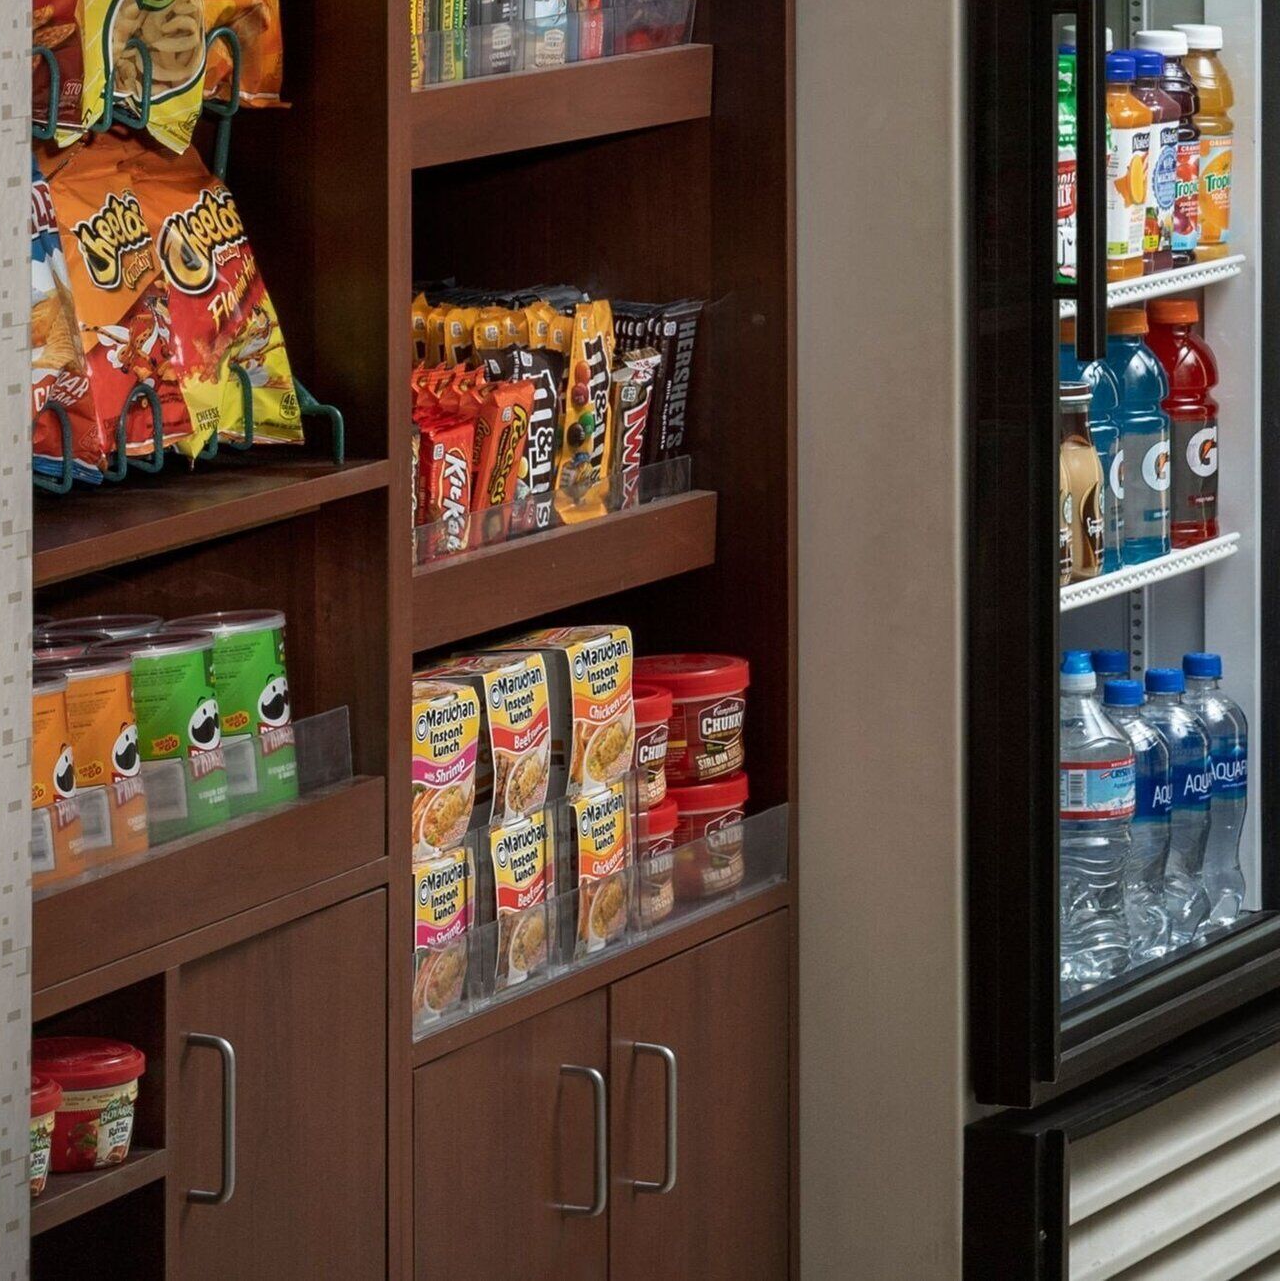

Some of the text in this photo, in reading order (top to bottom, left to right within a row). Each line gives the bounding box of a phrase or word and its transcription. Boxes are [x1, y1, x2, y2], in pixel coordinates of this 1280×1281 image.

[667, 320, 697, 449] HERSHEY'S
[196, 407, 220, 423] CHEESE
[491, 403, 528, 507] Reese's
[621, 385, 652, 510] TWIX
[444, 452, 467, 500] Kit
[582, 639, 629, 668] Maruchan
[499, 667, 543, 695] Maruchan
[587, 663, 619, 683] Instant
[592, 677, 617, 695] Lunch
[504, 690, 535, 712] Instant
[590, 700, 620, 719] Chicken
[426, 701, 475, 728] Maruchan
[509, 707, 533, 725] Lunch
[430, 724, 463, 745] Instant
[514, 730, 531, 749] Beef
[433, 740, 460, 758] Lunch
[436, 759, 465, 783] Shrimp
[698, 752, 728, 770] SIRLOIN
[587, 792, 624, 820] Maruchan
[503, 823, 548, 853] Maruchan
[591, 818, 616, 838] Instant
[595, 834, 615, 851] Lunch
[510, 849, 538, 869] Instant
[592, 856, 617, 874] Chicken
[428, 862, 469, 891] Maruchan
[514, 863, 536, 883] Lunch
[431, 887, 459, 907] Instant
[518, 889, 533, 907] Beef
[434, 903, 456, 920] Lunch
[437, 922, 461, 944] Shrimp
